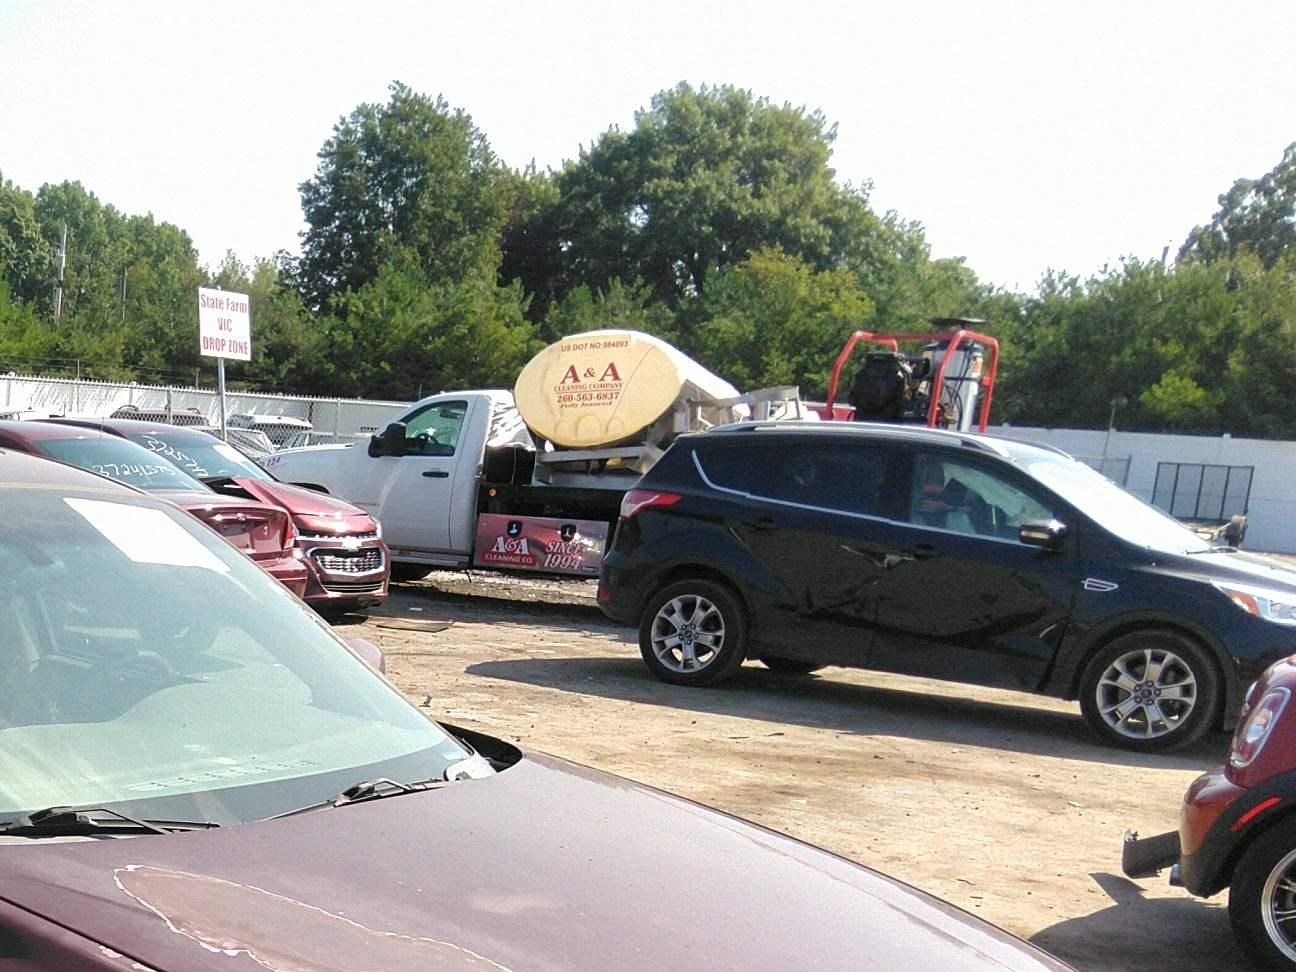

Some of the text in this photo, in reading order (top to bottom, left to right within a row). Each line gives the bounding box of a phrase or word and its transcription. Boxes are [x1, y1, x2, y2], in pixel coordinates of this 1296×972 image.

[200, 293, 248, 314] State Farm
[217, 316, 233, 332] VIC
[202, 335, 249, 355] DROP ZONE
[560, 343, 571, 352] US
[572, 342, 588, 351] DOT
[560, 361, 622, 384] A & A
[553, 382, 623, 392] CLEANING COMPANY
[557, 391, 621, 403] 260-563-6837
[491, 535, 530, 555] A&A
[545, 540, 586, 556] SINCE
[484, 553, 521, 564] CLEANING
[543, 553, 583, 571] 1994
